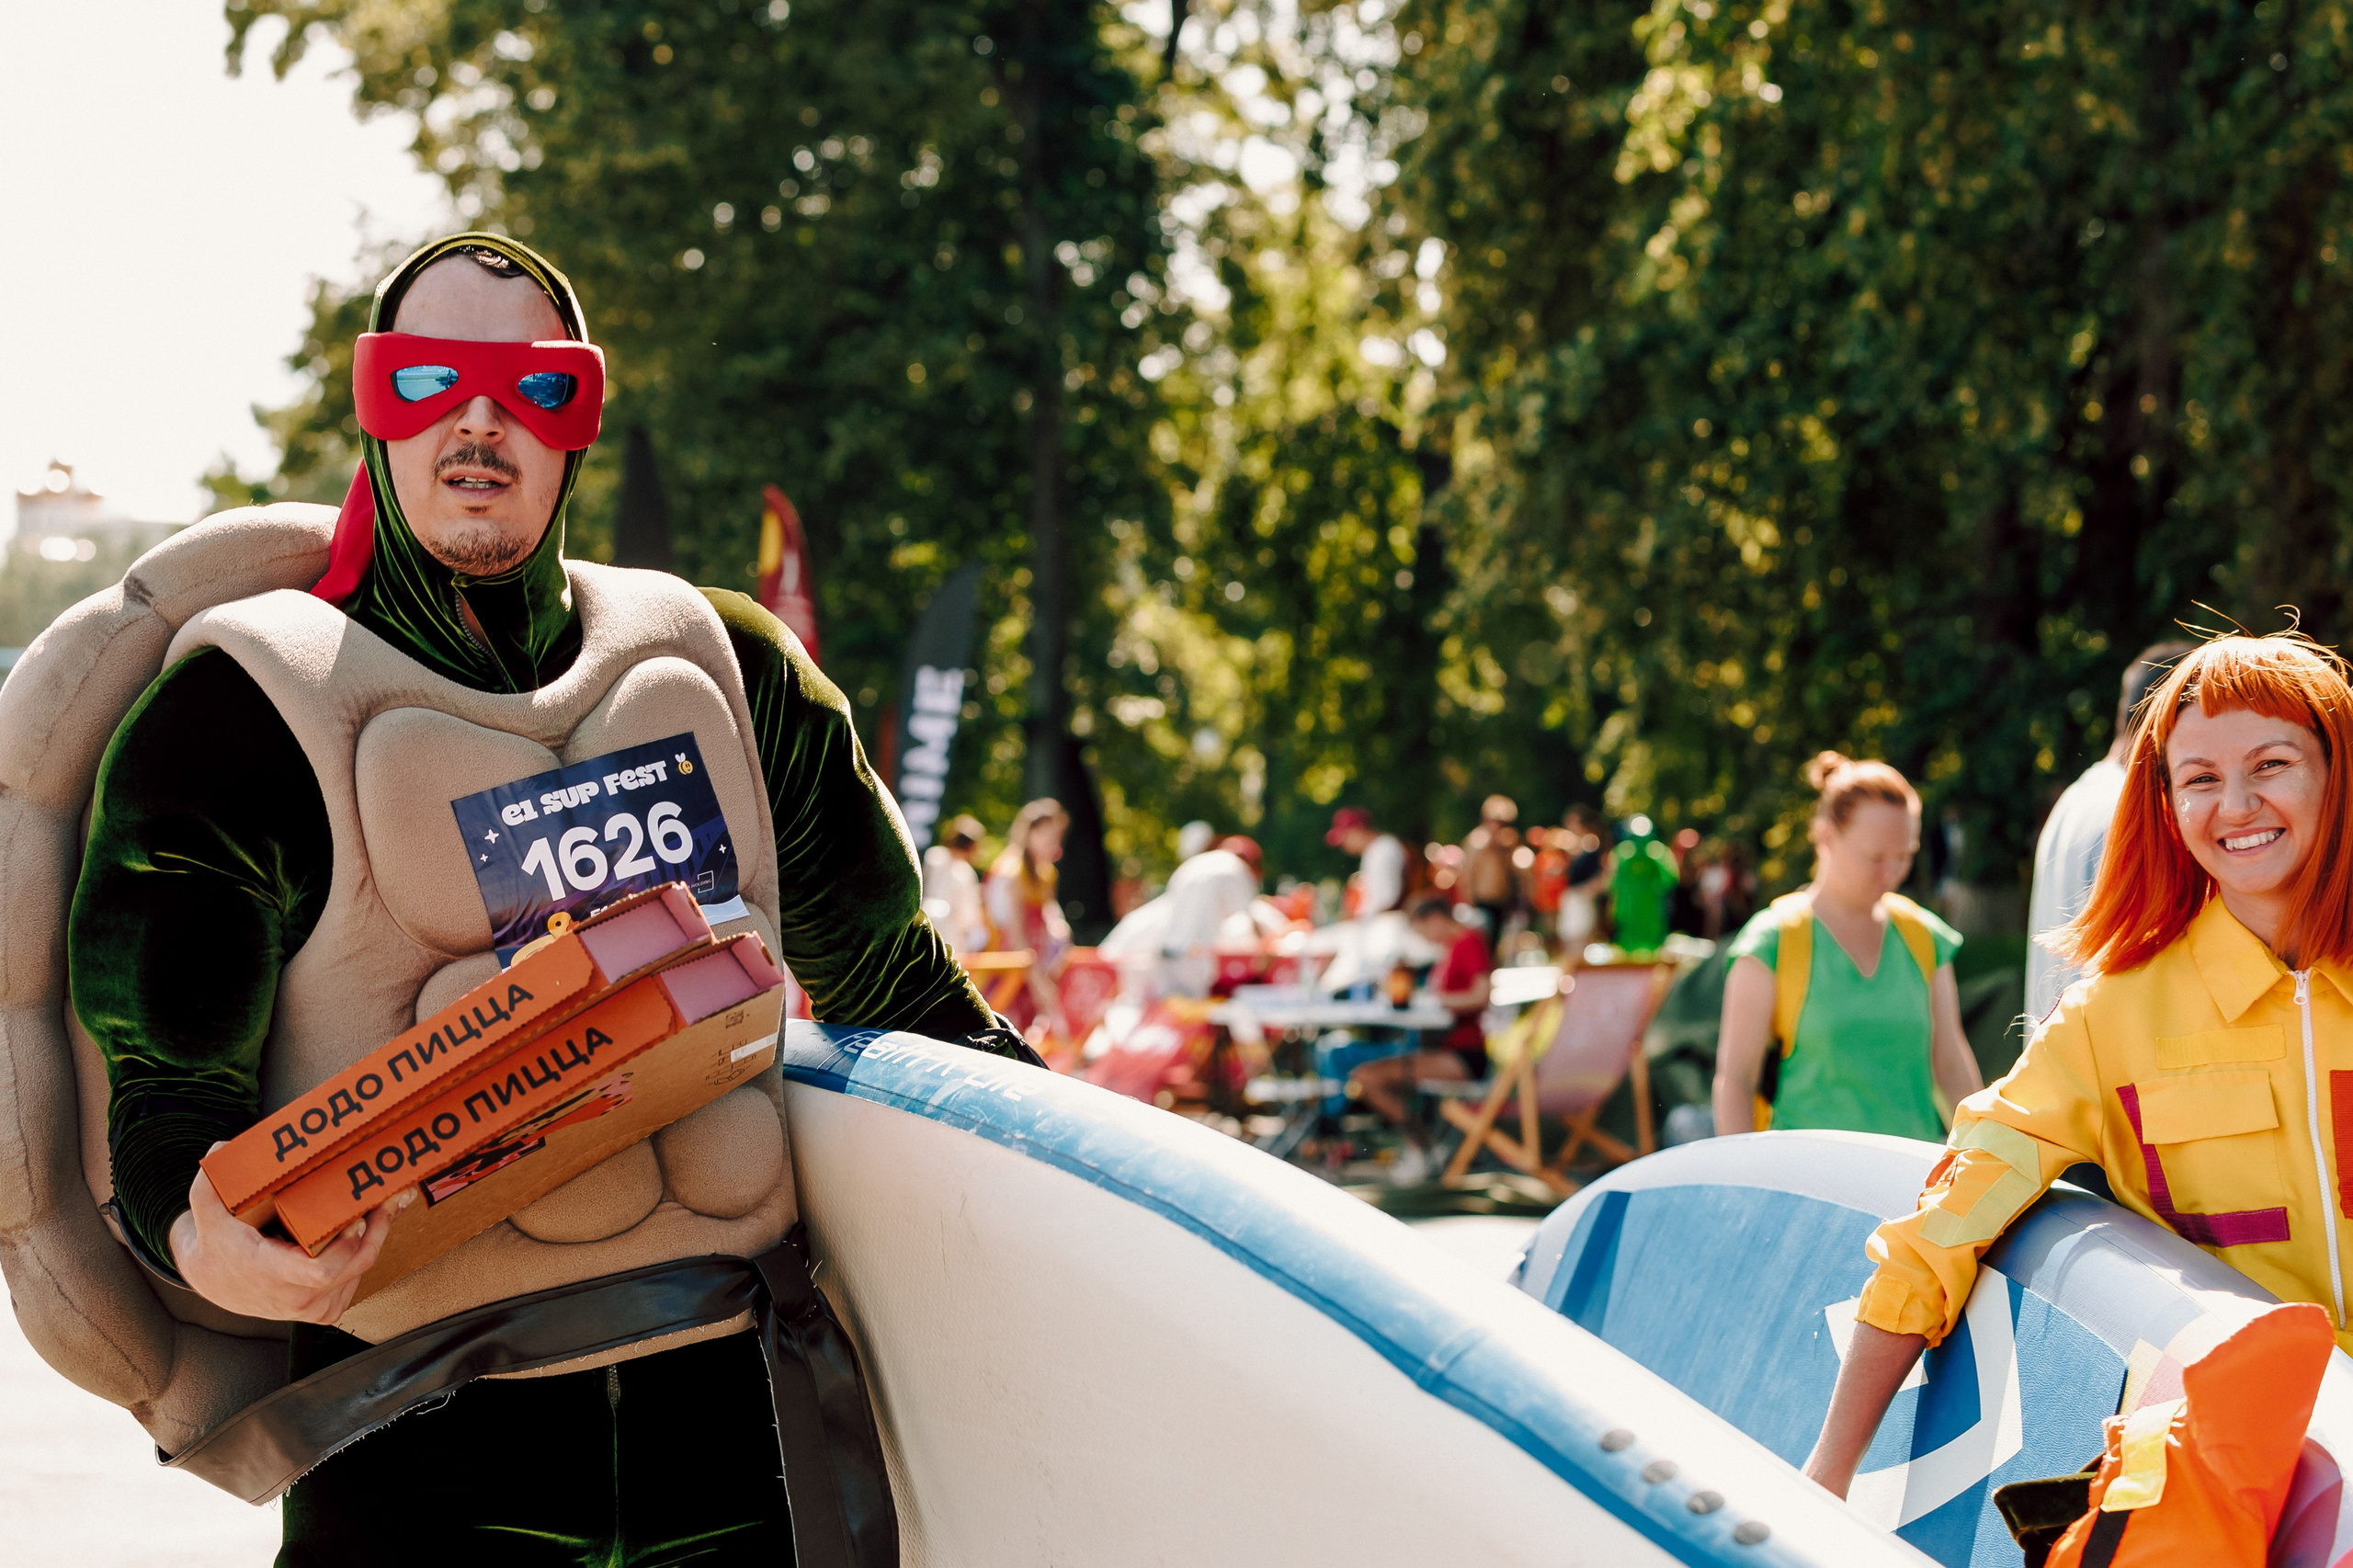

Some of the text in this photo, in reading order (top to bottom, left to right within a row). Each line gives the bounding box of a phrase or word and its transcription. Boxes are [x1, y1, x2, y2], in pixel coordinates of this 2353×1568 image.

[520, 801, 694, 902] 1626
[540, 781, 599, 816] SUP
[271, 983, 534, 1162] ДОДО ПИЦЦА
[346, 1027, 614, 1201] ДОДО ПИЦЦА
